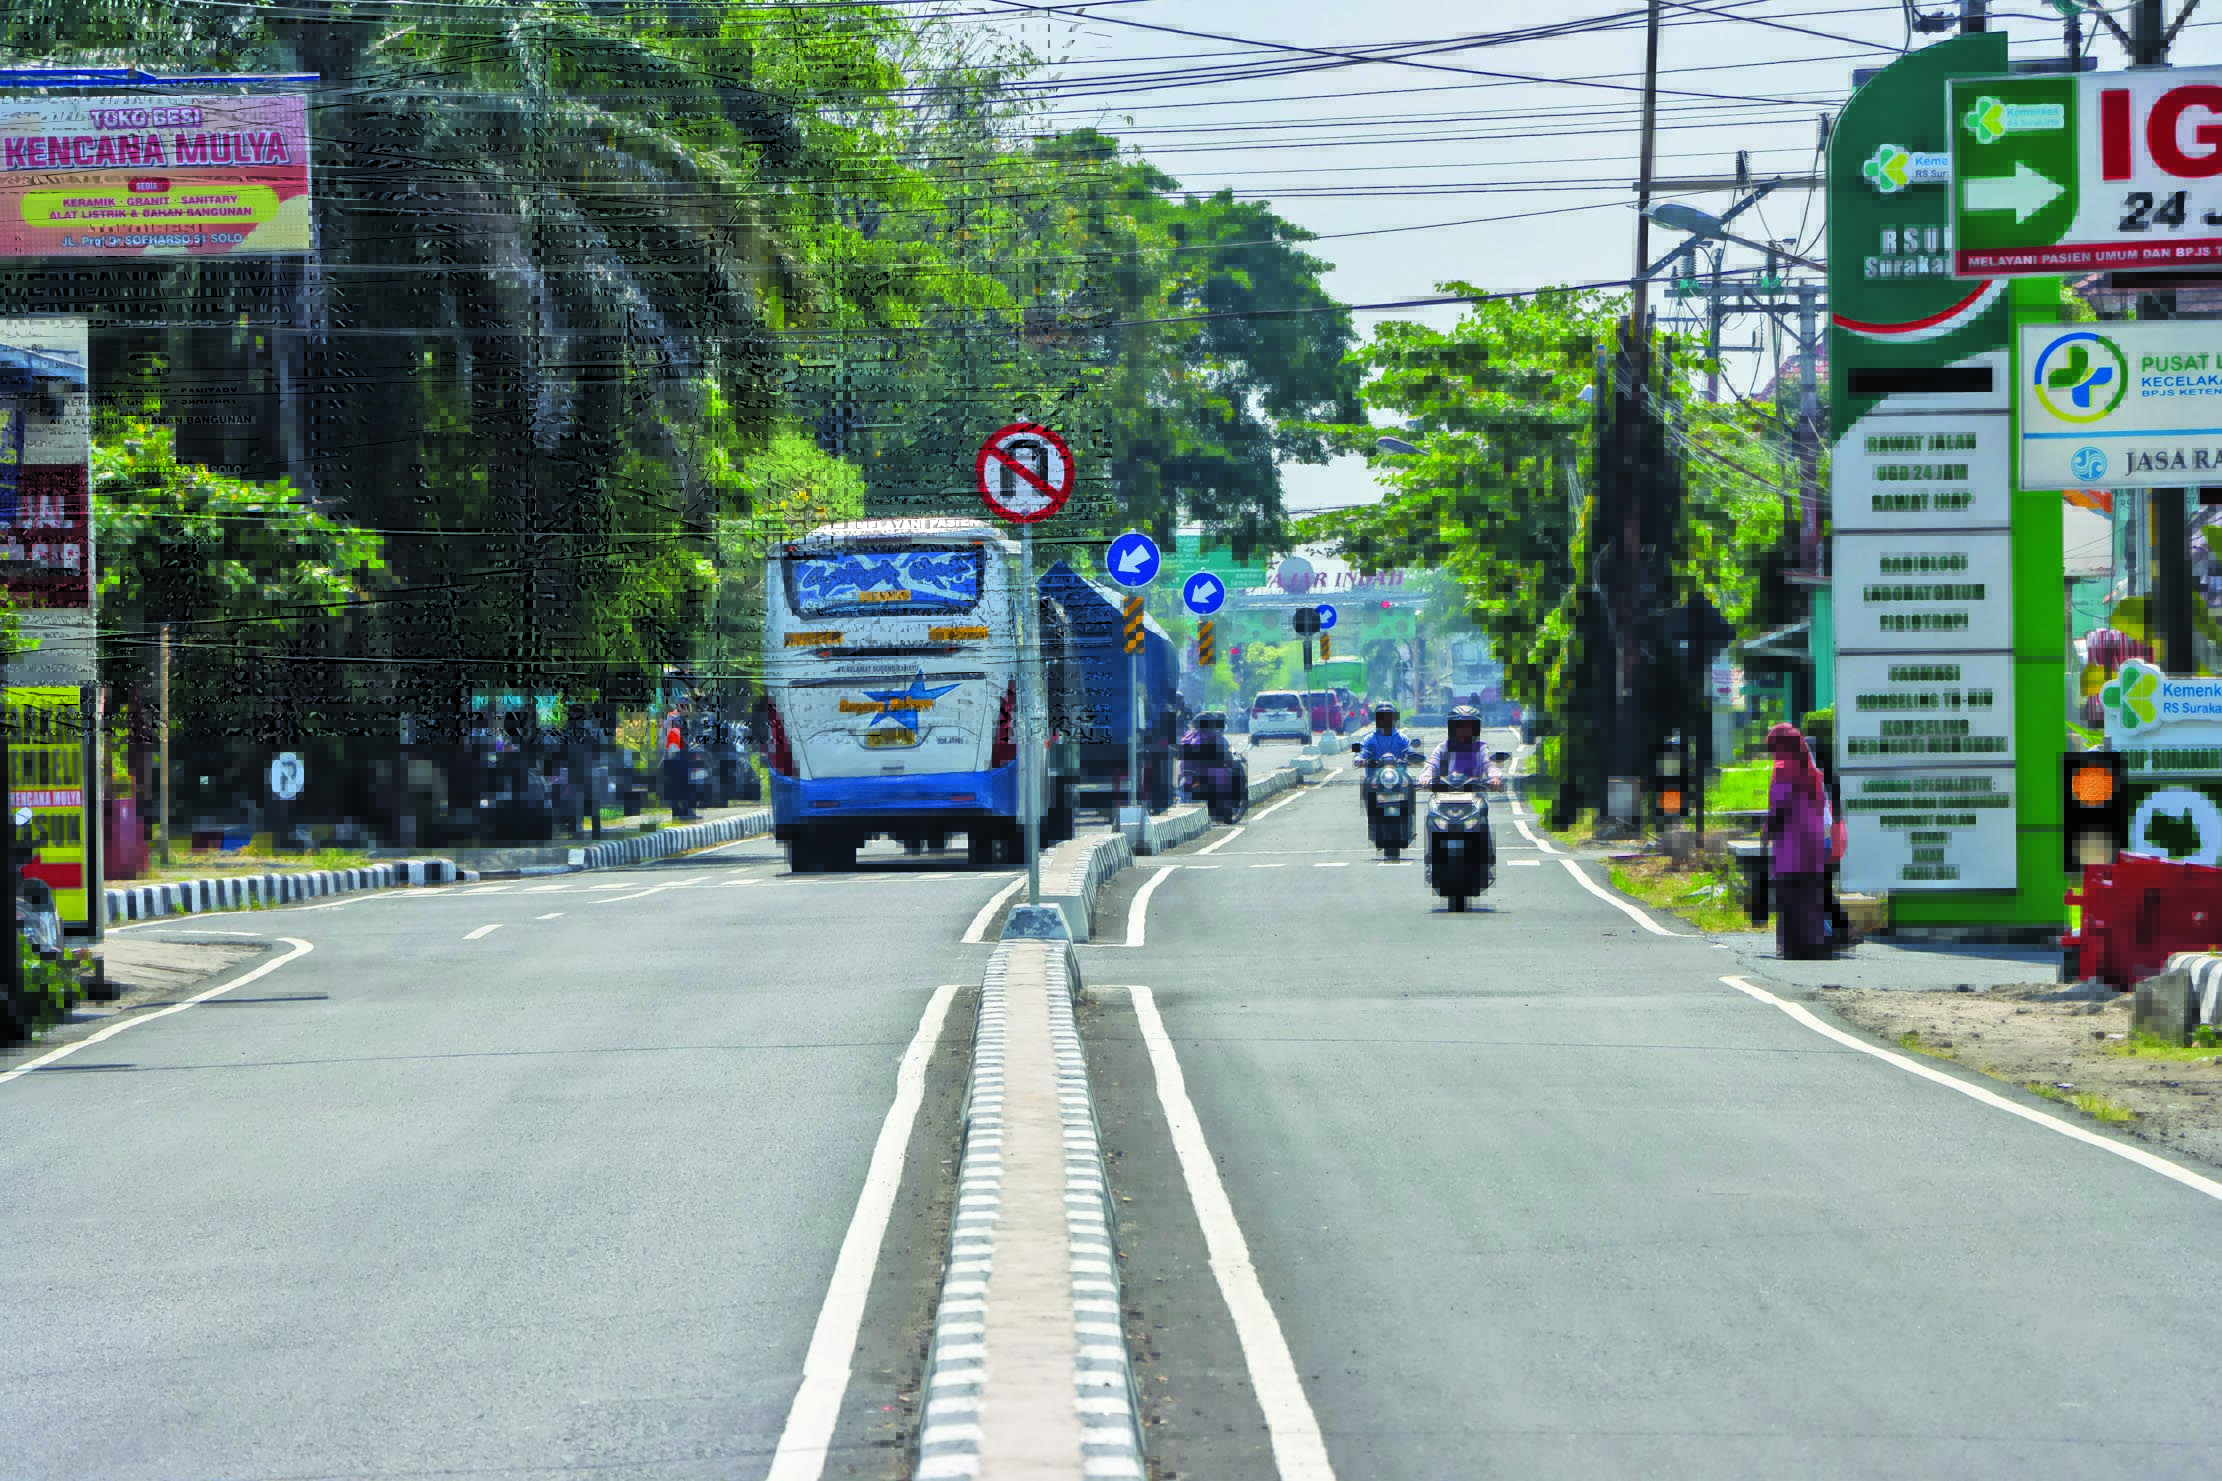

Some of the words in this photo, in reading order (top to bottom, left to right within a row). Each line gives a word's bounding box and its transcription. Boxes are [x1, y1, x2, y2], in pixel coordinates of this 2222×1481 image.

[90, 109, 148, 131] TOKO
[152, 107, 202, 129] BESI
[4, 135, 168, 169] KENCANA
[174, 131, 289, 167] MULYA
[1915, 170, 1929, 178] RS
[1931, 170, 1949, 178] Sur
[63, 198, 115, 208] KERAMIK
[127, 196, 169, 206] GRANIT
[181, 195, 237, 205] SANITARY
[50, 210, 77, 219] ALAT
[82, 209, 126, 219] LISTRIK
[143, 208, 183, 217] BAHAN
[187, 207, 252, 217] BANGUNAN
[2118, 191, 2187, 230] 24
[211, 233, 243, 243] SOLO
[1968, 255, 2037, 268] MELAYANI
[2042, 252, 2091, 264] PASIEN
[2096, 250, 2138, 261] UMUM
[2143, 248, 2170, 259] DAN
[2175, 247, 2210, 257] BPJS
[2141, 354, 2209, 373] PUSAT
[2141, 374, 2222, 388] KECELAK
[2142, 388, 2175, 398] BPJS
[1867, 435, 1924, 453] RAWAT
[1913, 464, 1933, 481] 24
[1936, 464, 1968, 481] JAM
[2125, 451, 2187, 477] JASA
[2163, 702, 2179, 713] RS
